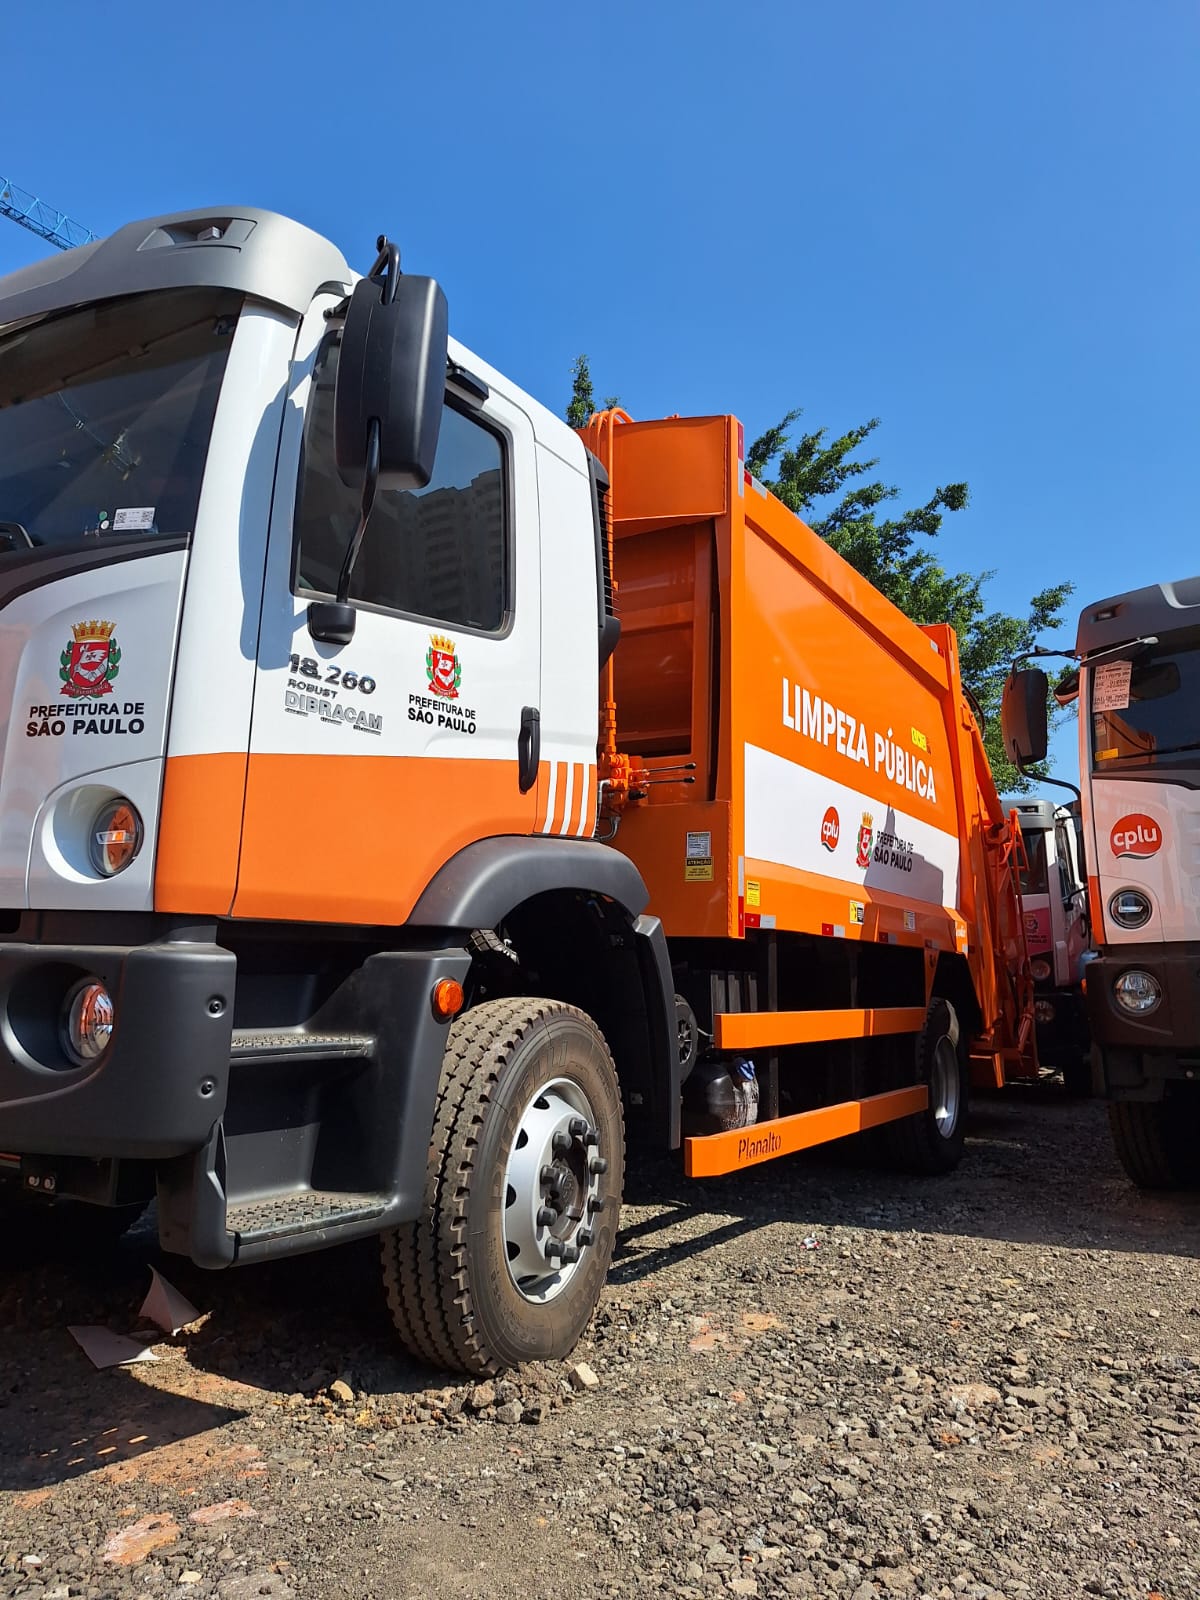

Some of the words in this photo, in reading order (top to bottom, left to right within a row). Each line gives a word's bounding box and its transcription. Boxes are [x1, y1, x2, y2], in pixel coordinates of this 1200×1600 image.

[289, 653, 376, 695] 18.260
[287, 678, 338, 699] ROBUST
[30, 703, 119, 718] PREFEITURA
[123, 702, 145, 715] DE
[285, 690, 383, 731] DIBRACAM
[409, 694, 463, 717] PREFEITURA
[465, 708, 476, 720] DE
[26, 716, 66, 737] SÃO
[72, 718, 145, 735] PAULO
[408, 706, 434, 725] SÃO
[438, 714, 477, 735] PAULO
[782, 677, 870, 768] LIMPEZA
[874, 727, 937, 803] PÚBLICA
[822, 819, 839, 841] cplu
[876, 830, 907, 853] PREFEITURA
[907, 842, 914, 855] DE
[1113, 825, 1158, 850] cplu
[874, 845, 889, 866] SÃO
[890, 851, 913, 873] PAULO
[738, 1131, 782, 1162] Planalto
